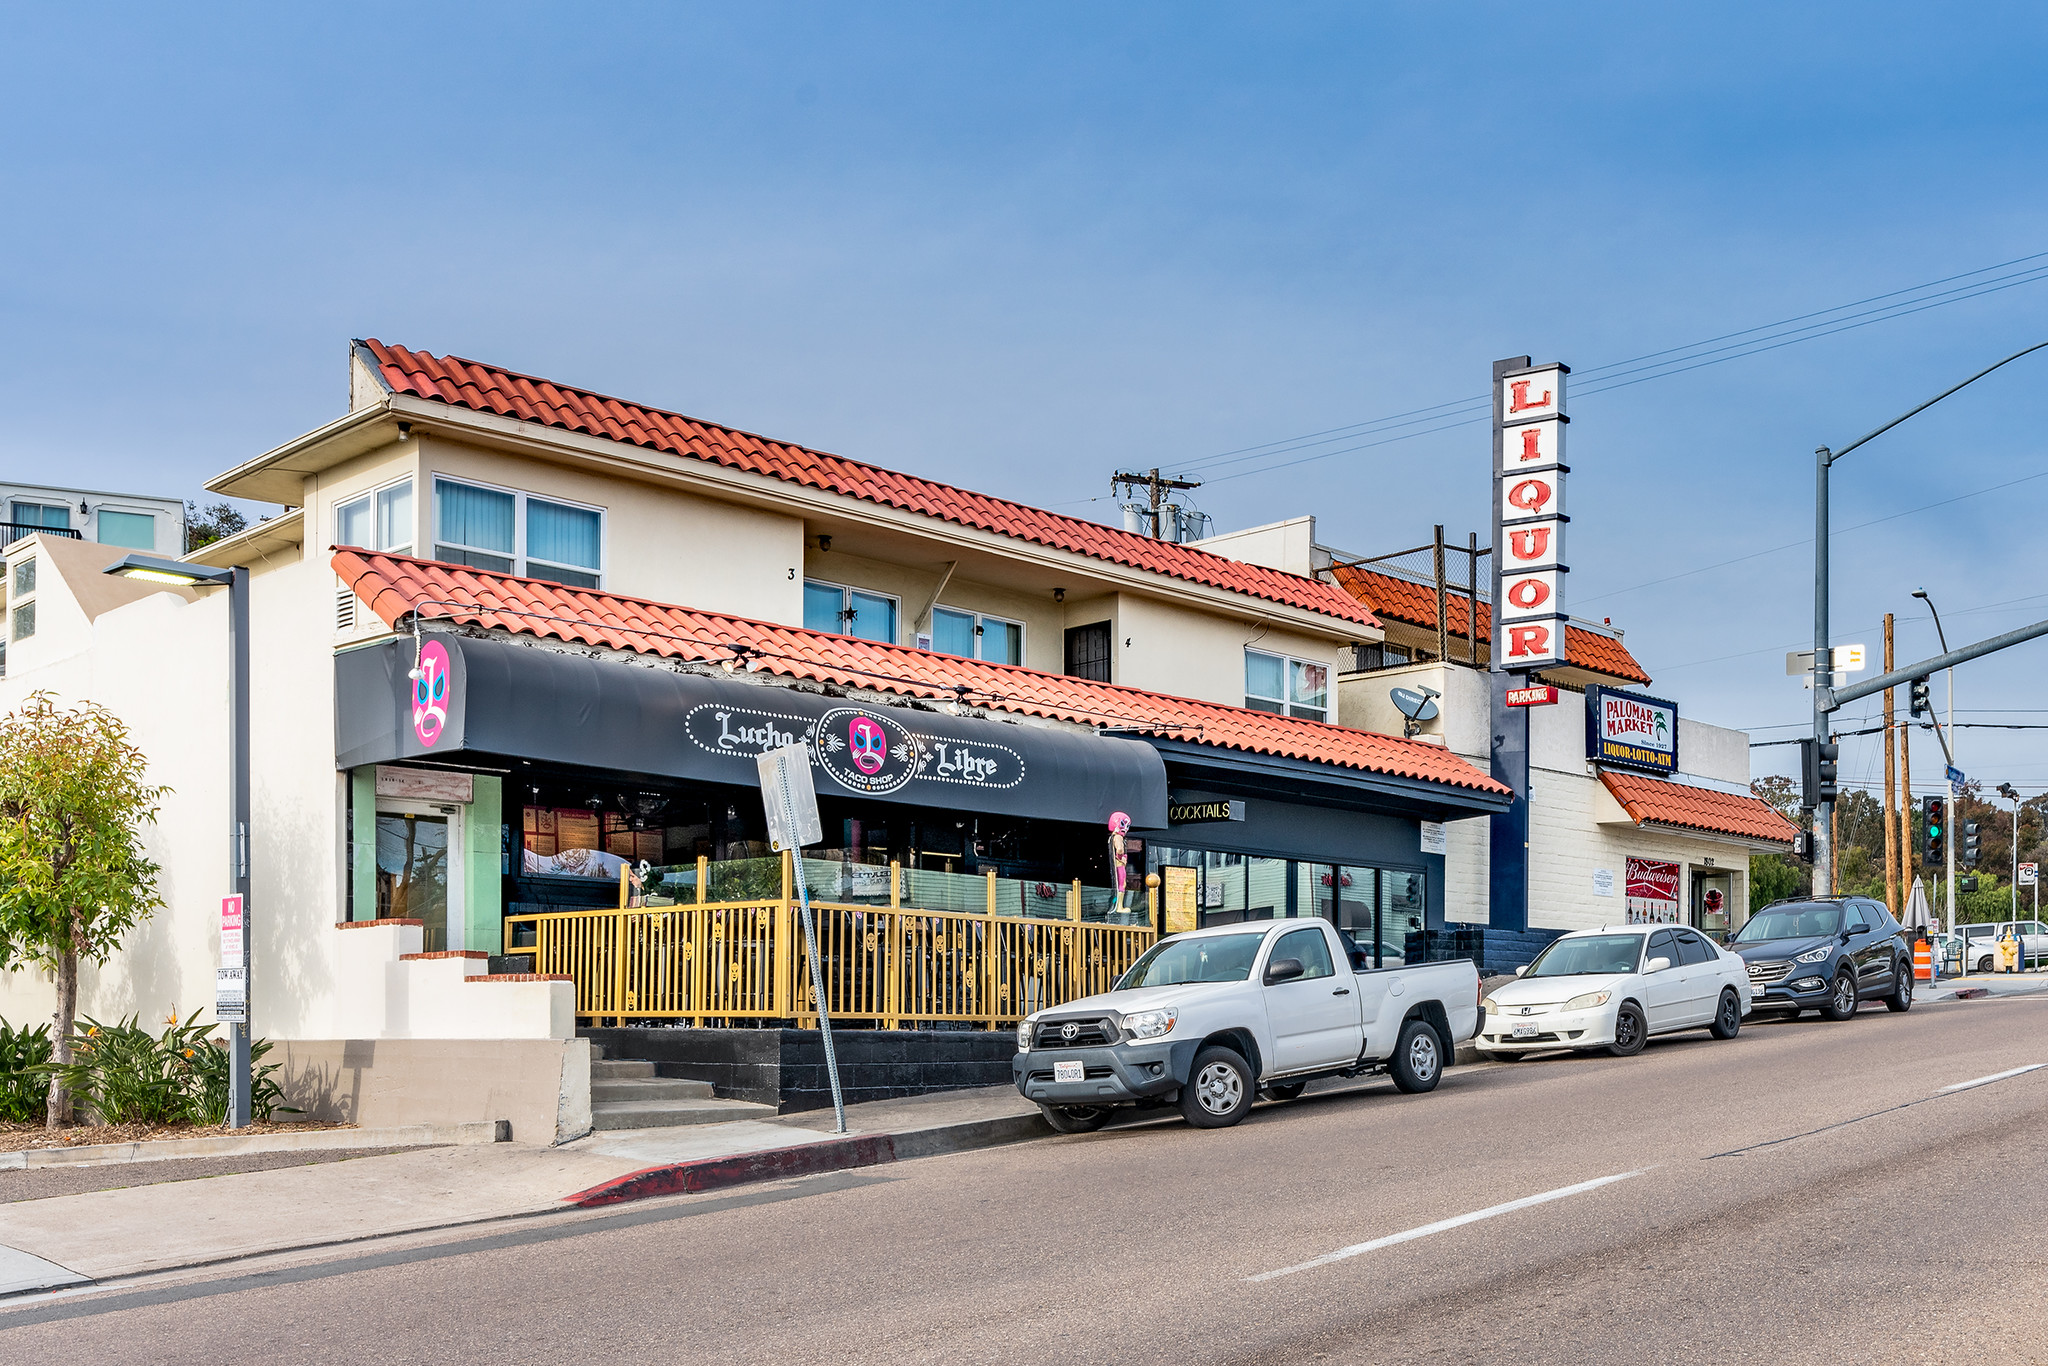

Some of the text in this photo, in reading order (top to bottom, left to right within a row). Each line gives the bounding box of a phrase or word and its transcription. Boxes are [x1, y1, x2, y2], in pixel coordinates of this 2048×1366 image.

[1508, 379, 1552, 657] LIQUOR
[788, 568, 795, 580] 3
[1125, 637, 1131, 648] 4
[1508, 688, 1547, 704] PARKING
[1606, 700, 1653, 723] PALOMAR
[1607, 719, 1653, 737] MARKET
[934, 742, 998, 781] Libre
[844, 767, 893, 784] TACO SHOP
[1170, 803, 1230, 820] COCKTAILS
[1625, 861, 1677, 884] Budweiser
[227, 901, 236, 914] NO
[222, 914, 242, 927] PARKING
